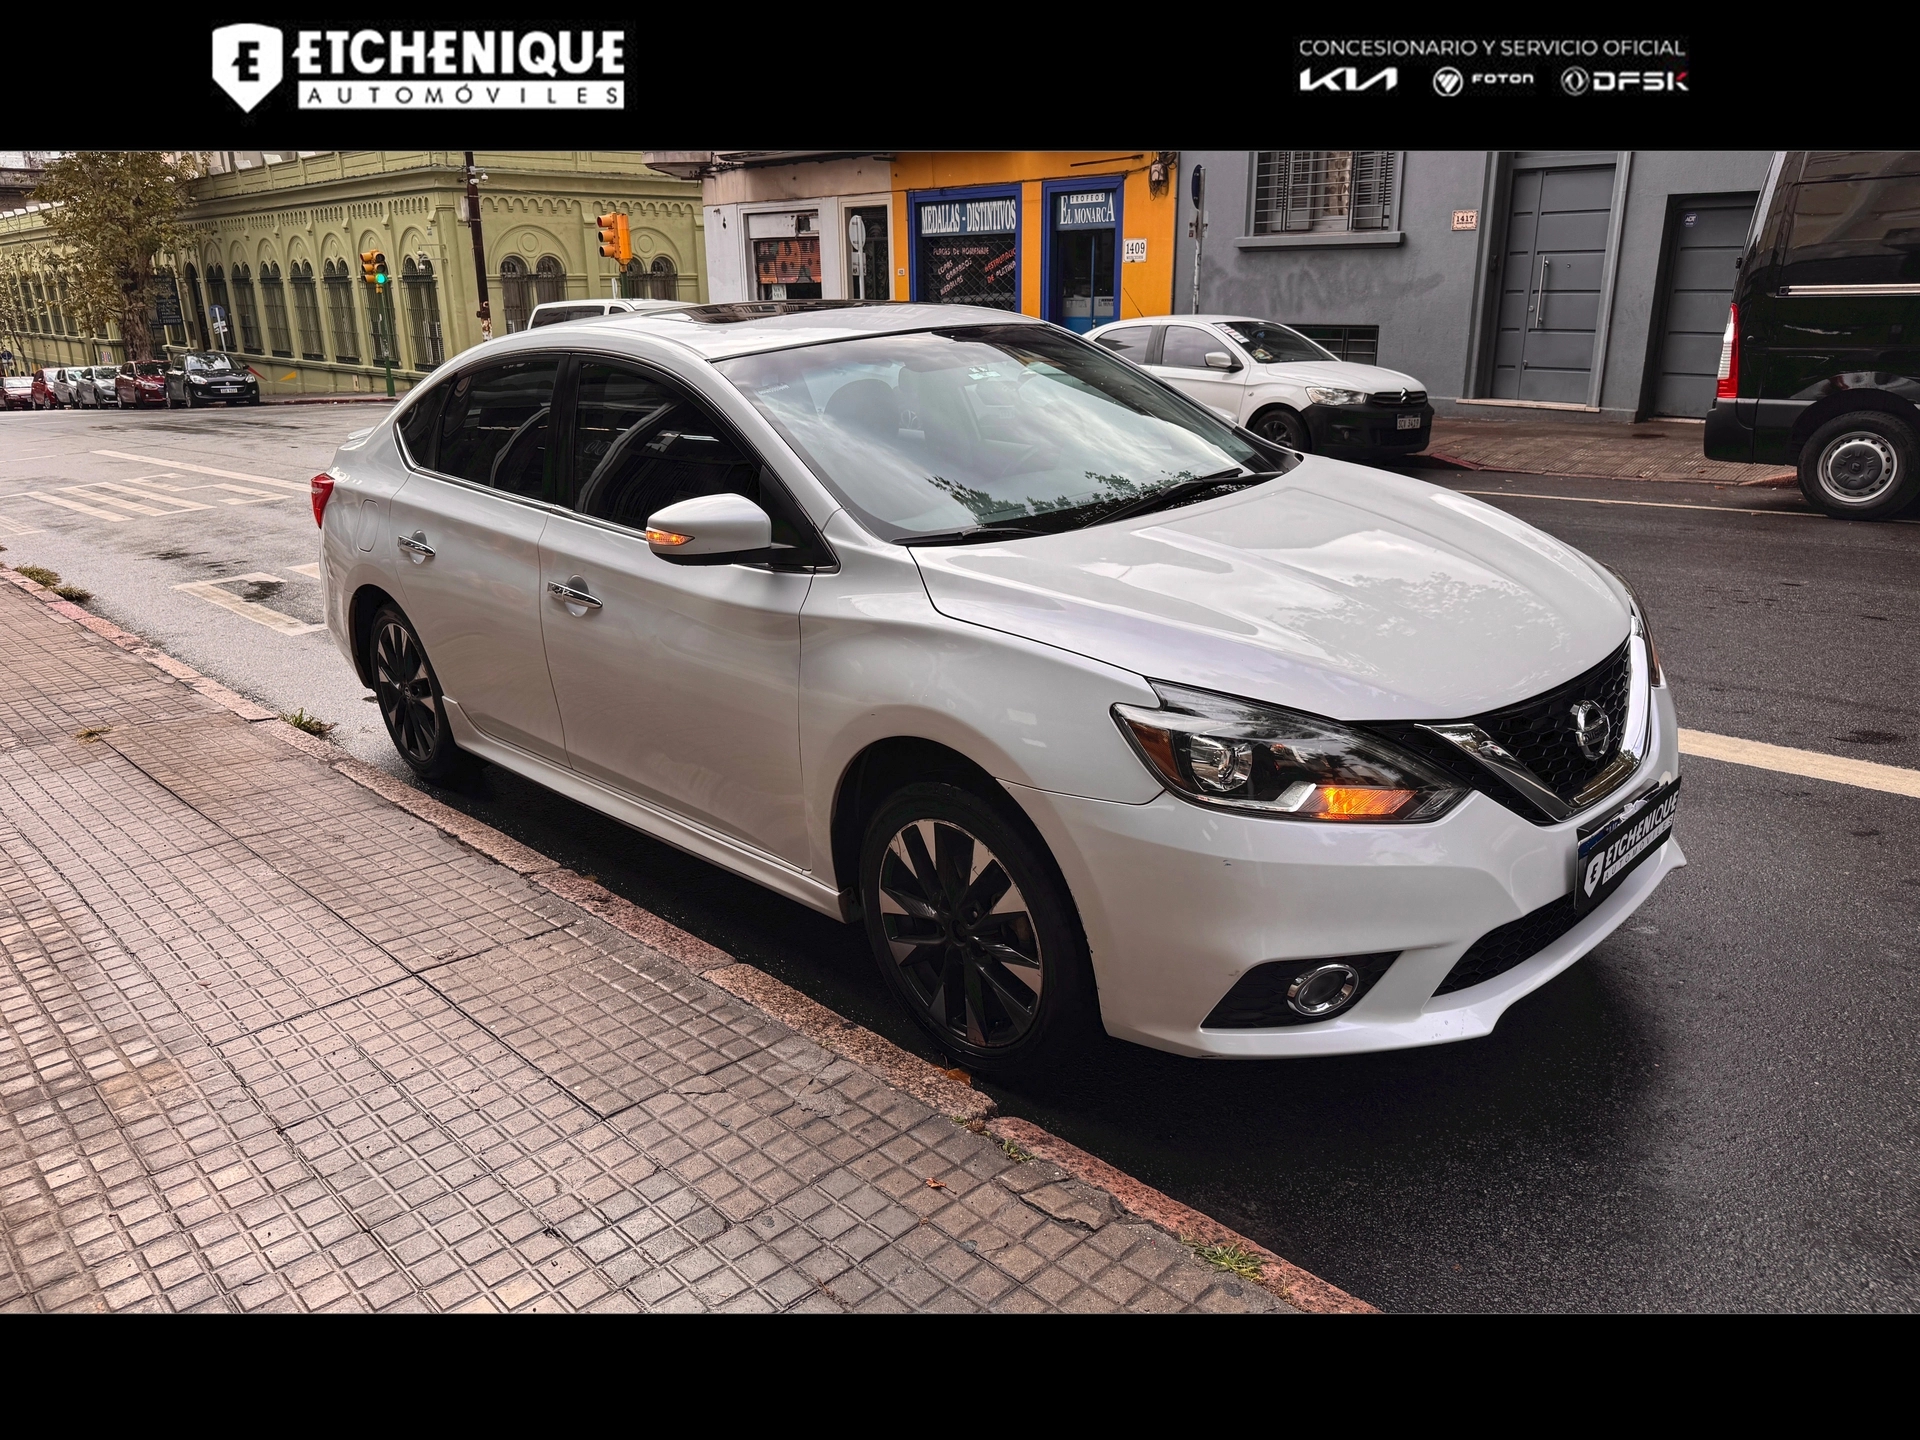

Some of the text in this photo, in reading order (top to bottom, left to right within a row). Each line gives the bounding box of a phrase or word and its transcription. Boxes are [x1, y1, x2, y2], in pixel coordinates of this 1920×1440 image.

[1060, 192, 1116, 225] EL MONARCA
[1071, 193, 1104, 203] TROFEOS
[921, 203, 960, 234] MEDALLAS
[966, 199, 1017, 232] DISTINTIVOS
[1126, 242, 1146, 255] 1409
[1604, 790, 1679, 869] ETCHENIQUE
